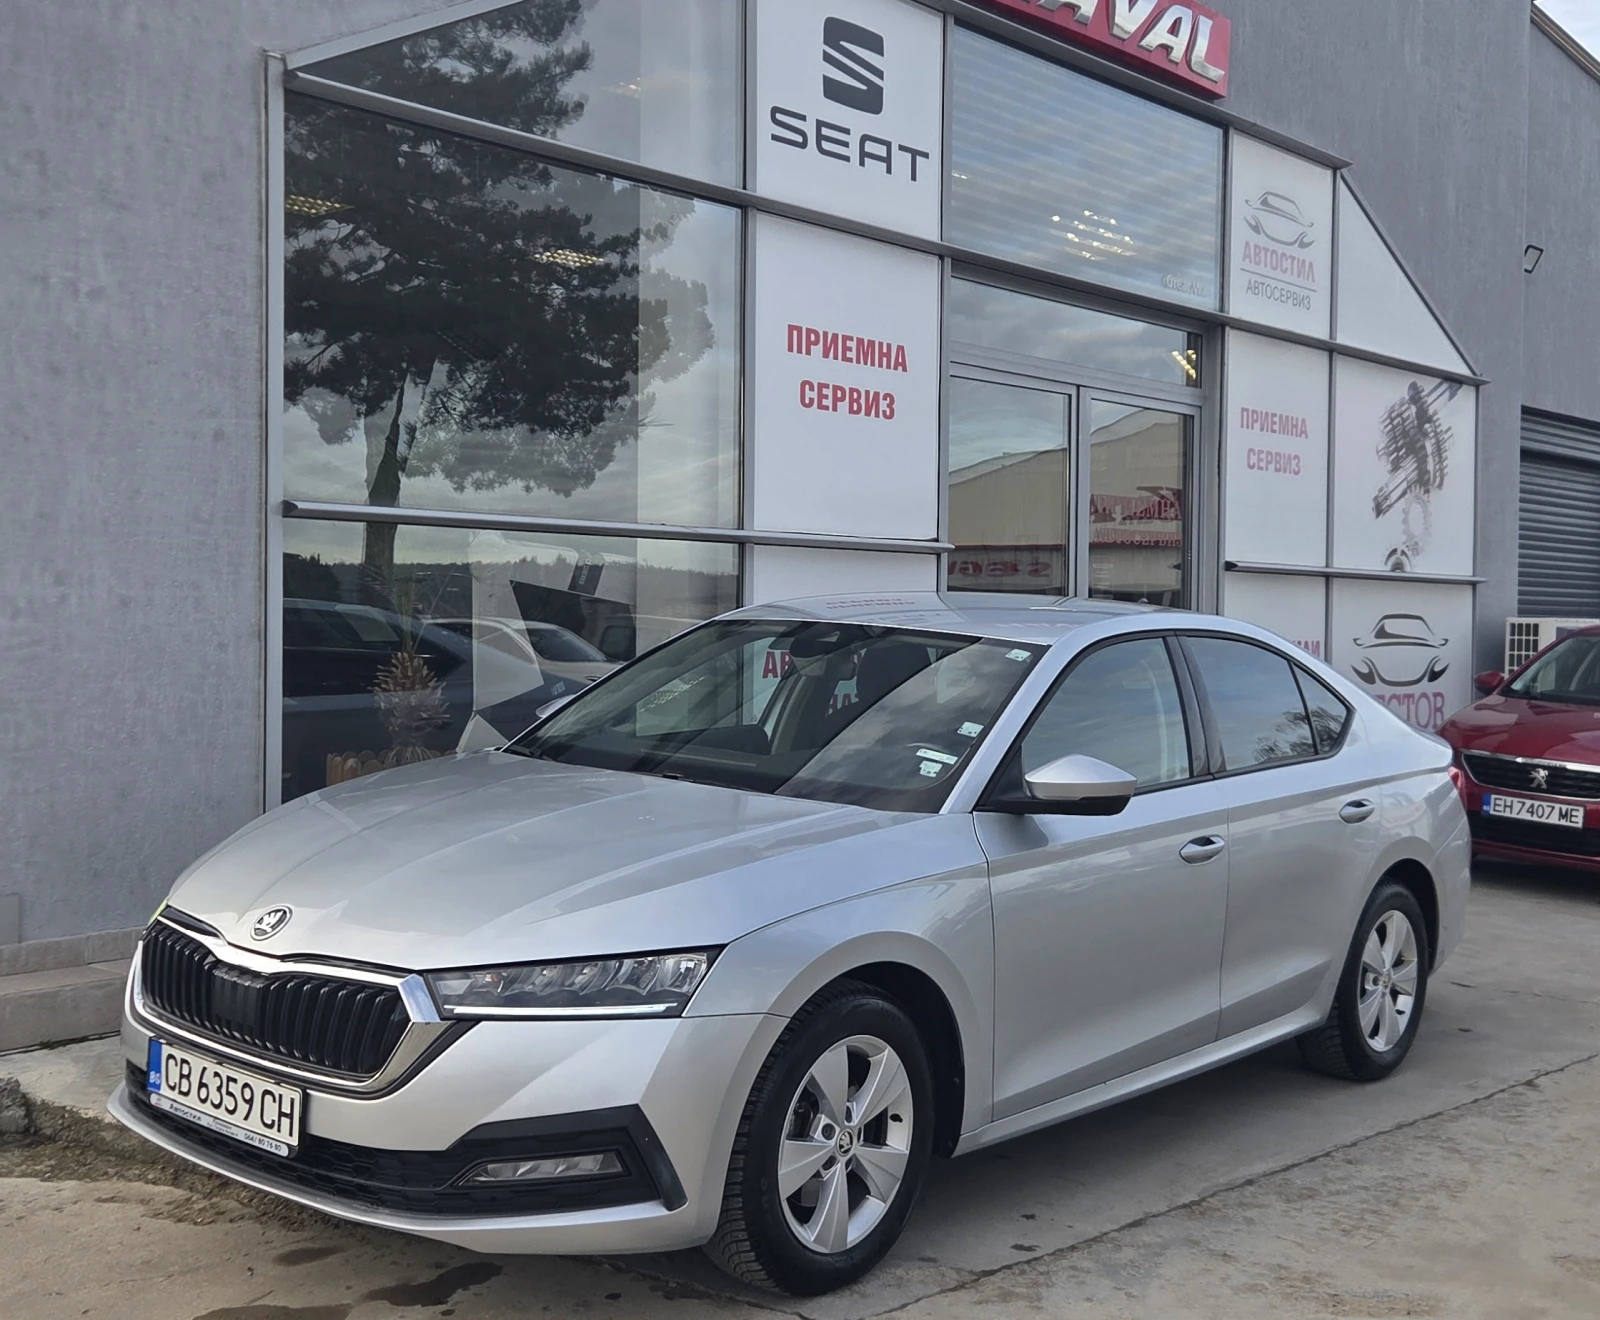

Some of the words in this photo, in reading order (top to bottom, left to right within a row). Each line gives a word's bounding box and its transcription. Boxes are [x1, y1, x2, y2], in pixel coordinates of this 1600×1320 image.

[770, 106, 930, 182] SEAT
[1242, 241, 1316, 283] АВТОСТИЛ
[1246, 279, 1311, 311] АВТОСЕРВИЗ
[787, 324, 908, 372] ПРИЕМНА
[799, 379, 895, 420] СЕРВИЗ
[1240, 407, 1309, 439] ПРИЕМНА
[1246, 447, 1302, 477] СЕРВИЗ
[1493, 797, 1514, 815] EH
[1516, 801, 1555, 820] 7407
[1558, 807, 1580, 824] ME
[165, 1053, 192, 1098] CB
[197, 1066, 255, 1121] 6359
[260, 1088, 296, 1138] CH
